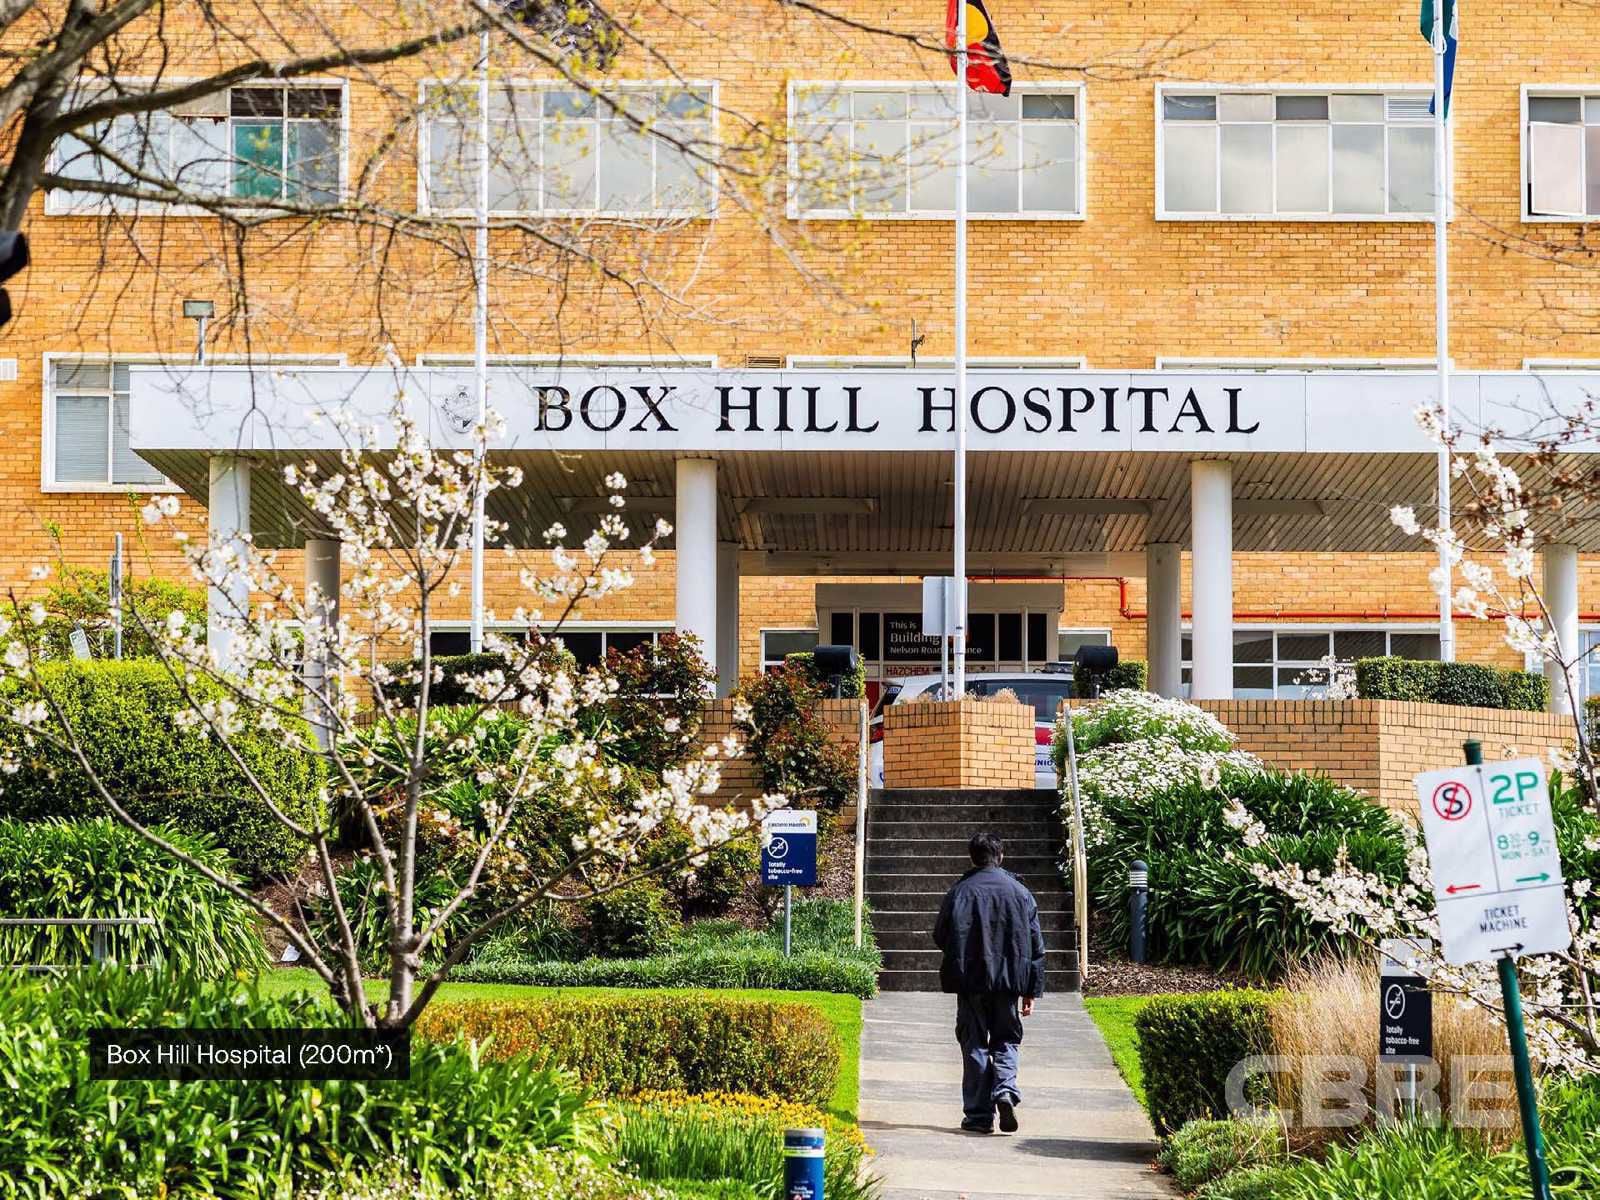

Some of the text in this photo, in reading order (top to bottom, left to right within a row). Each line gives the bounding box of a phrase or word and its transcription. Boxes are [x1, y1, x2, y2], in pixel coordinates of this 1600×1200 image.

[532, 385, 1261, 434] BOX HILL HOSPITAL
[890, 633, 940, 645] Building
[890, 646, 919, 654] Nelson
[886, 666, 930, 676] HAZCHEM
[1490, 771, 1539, 804] 2P
[1498, 803, 1540, 818] TICKET
[1484, 905, 1520, 919] TICKET
[1480, 917, 1528, 933] MACHINE
[1386, 1036, 1420, 1045] tobacco-free
[1386, 1046, 1396, 1055] site
